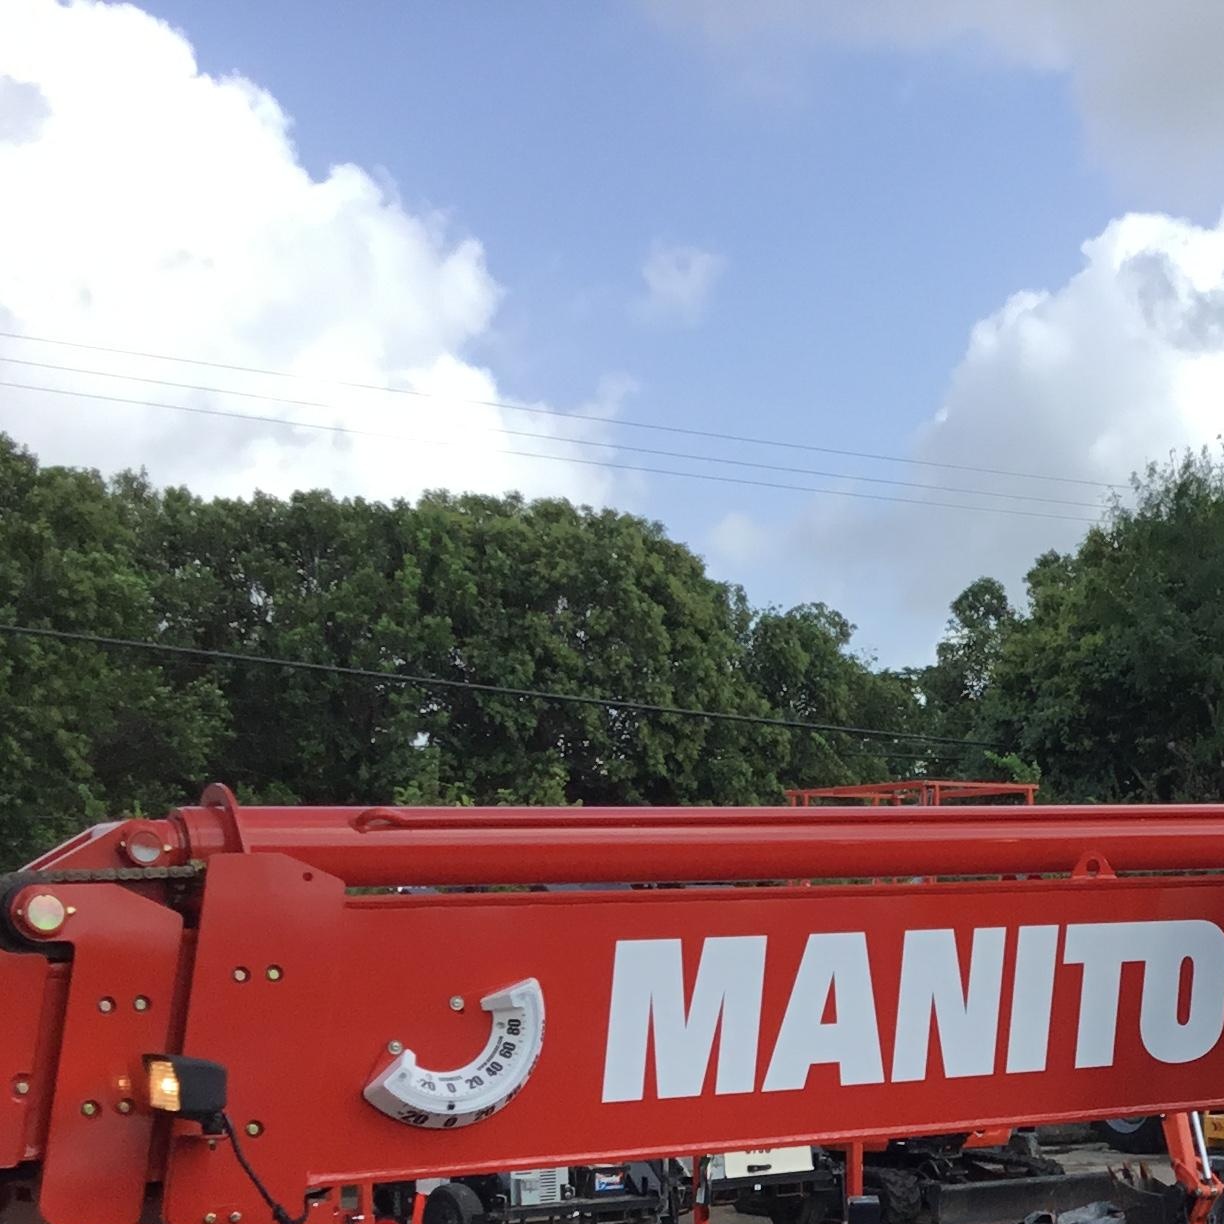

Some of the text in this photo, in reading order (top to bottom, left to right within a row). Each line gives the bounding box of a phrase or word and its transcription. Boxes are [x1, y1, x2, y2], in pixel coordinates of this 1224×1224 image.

[506, 1019, 521, 1036] 80
[499, 1041, 516, 1059] 60
[485, 1061, 503, 1077] 40
[446, 1082, 456, 1093] 0
[465, 1075, 484, 1089] 20
